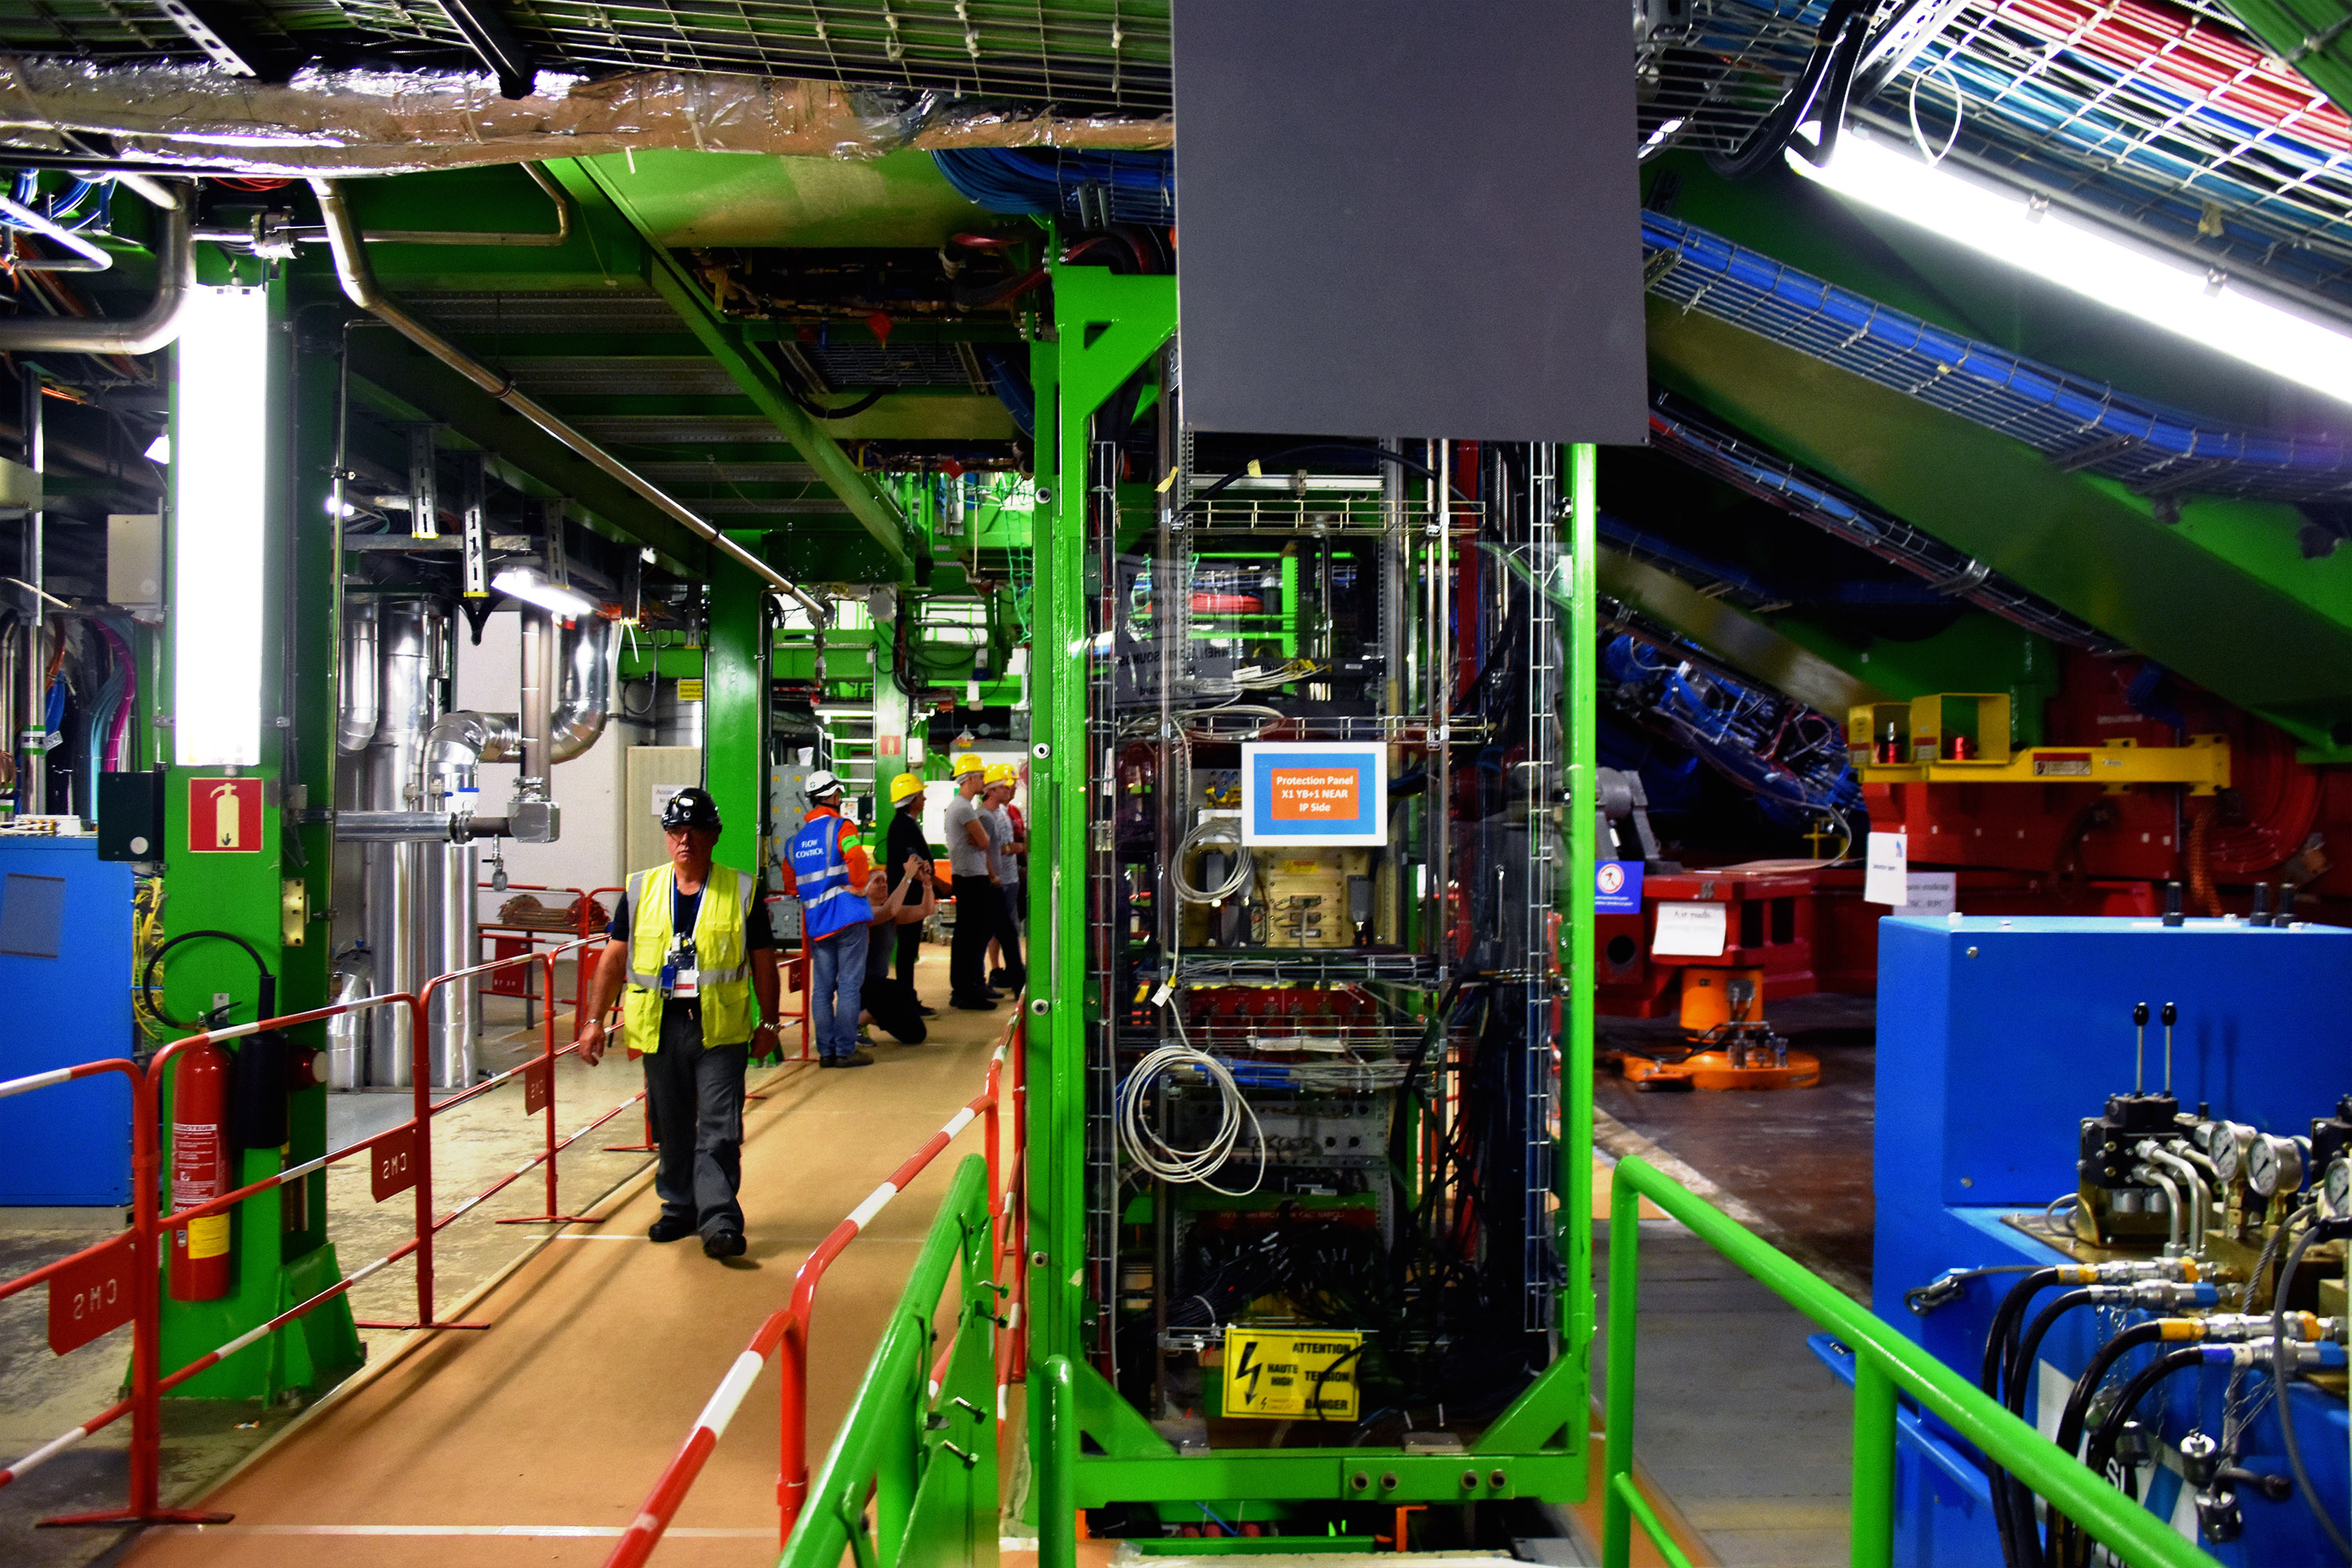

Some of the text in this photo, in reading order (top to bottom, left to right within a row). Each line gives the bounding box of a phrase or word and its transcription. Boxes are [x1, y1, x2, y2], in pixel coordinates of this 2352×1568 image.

[1276, 775, 1354, 785] Protection Panel
[1282, 789, 1348, 798] X1 YB+1 NEAR
[1299, 802, 1331, 811] IP Side
[801, 839, 818, 848] FLOW
[795, 848, 824, 858] CONTROL
[1292, 1342, 1351, 1355] ATTENTION
[1268, 1363, 1298, 1374] HAUTE
[1305, 1370, 1350, 1381] TESION
[1271, 1377, 1294, 1386] HIGH
